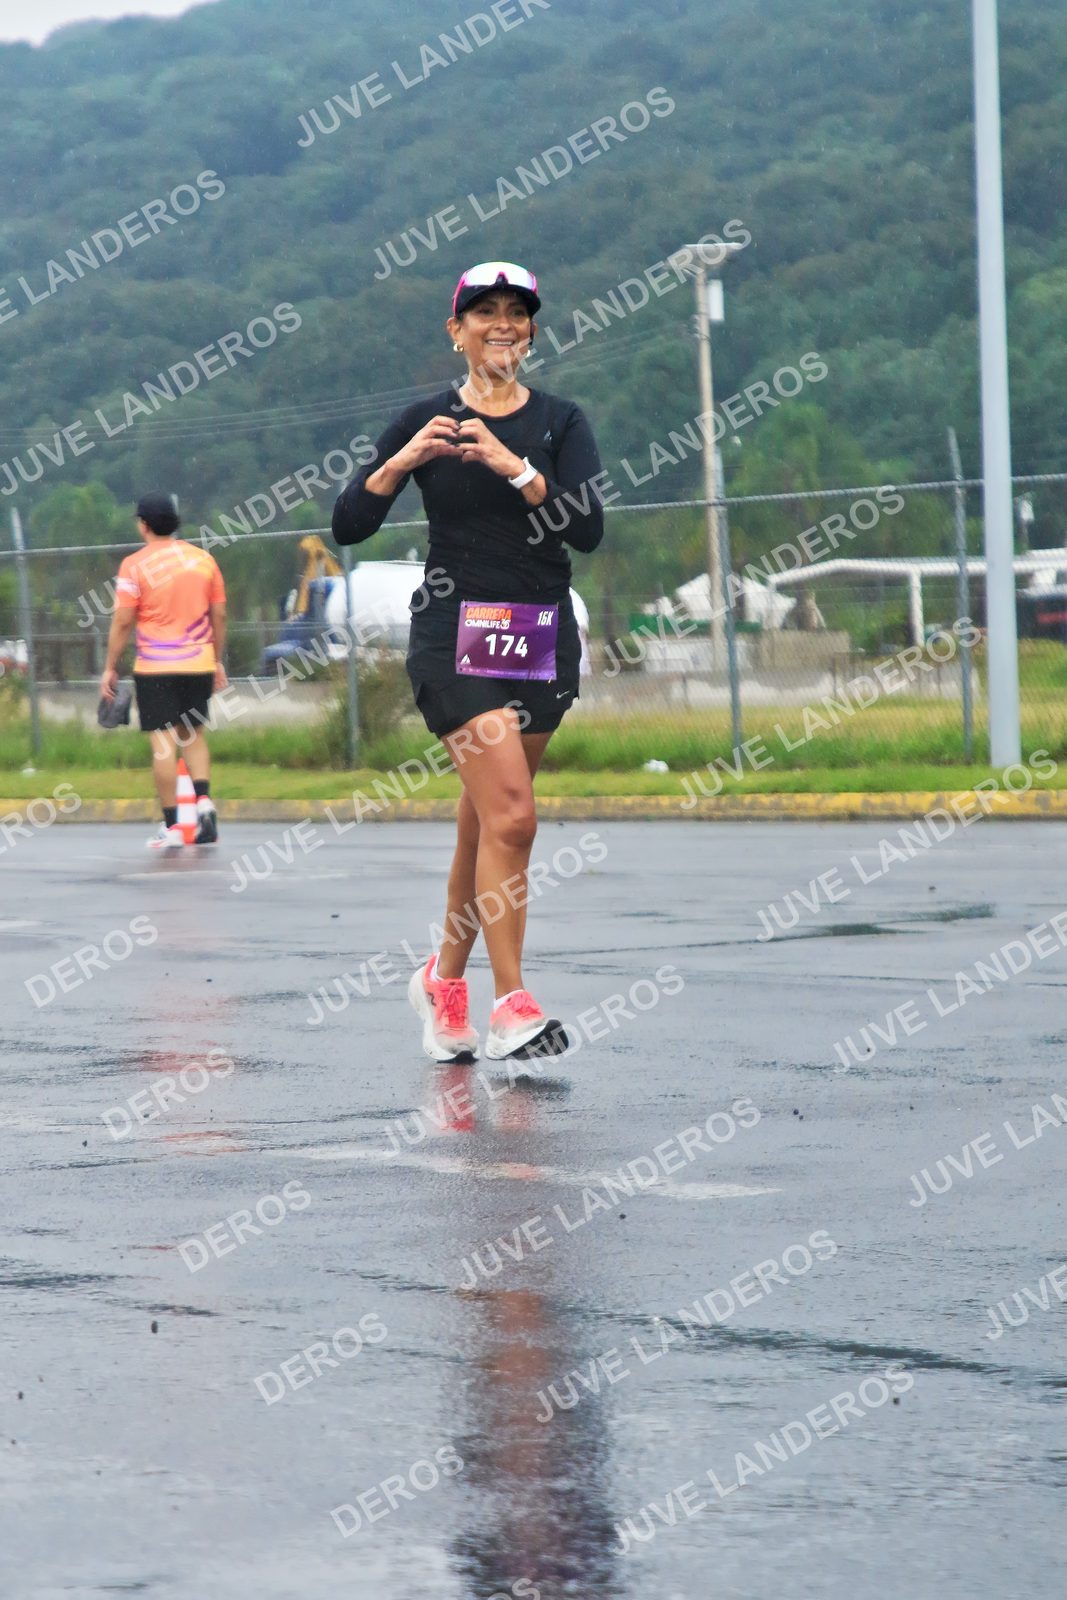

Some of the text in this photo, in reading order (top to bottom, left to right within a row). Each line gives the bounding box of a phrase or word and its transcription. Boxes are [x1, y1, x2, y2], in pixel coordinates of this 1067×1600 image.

[465, 607, 512, 620] CARRERA
[537, 611, 554, 626] 16K
[465, 619, 500, 629] OMNILIFE
[485, 633, 528, 657] 174
